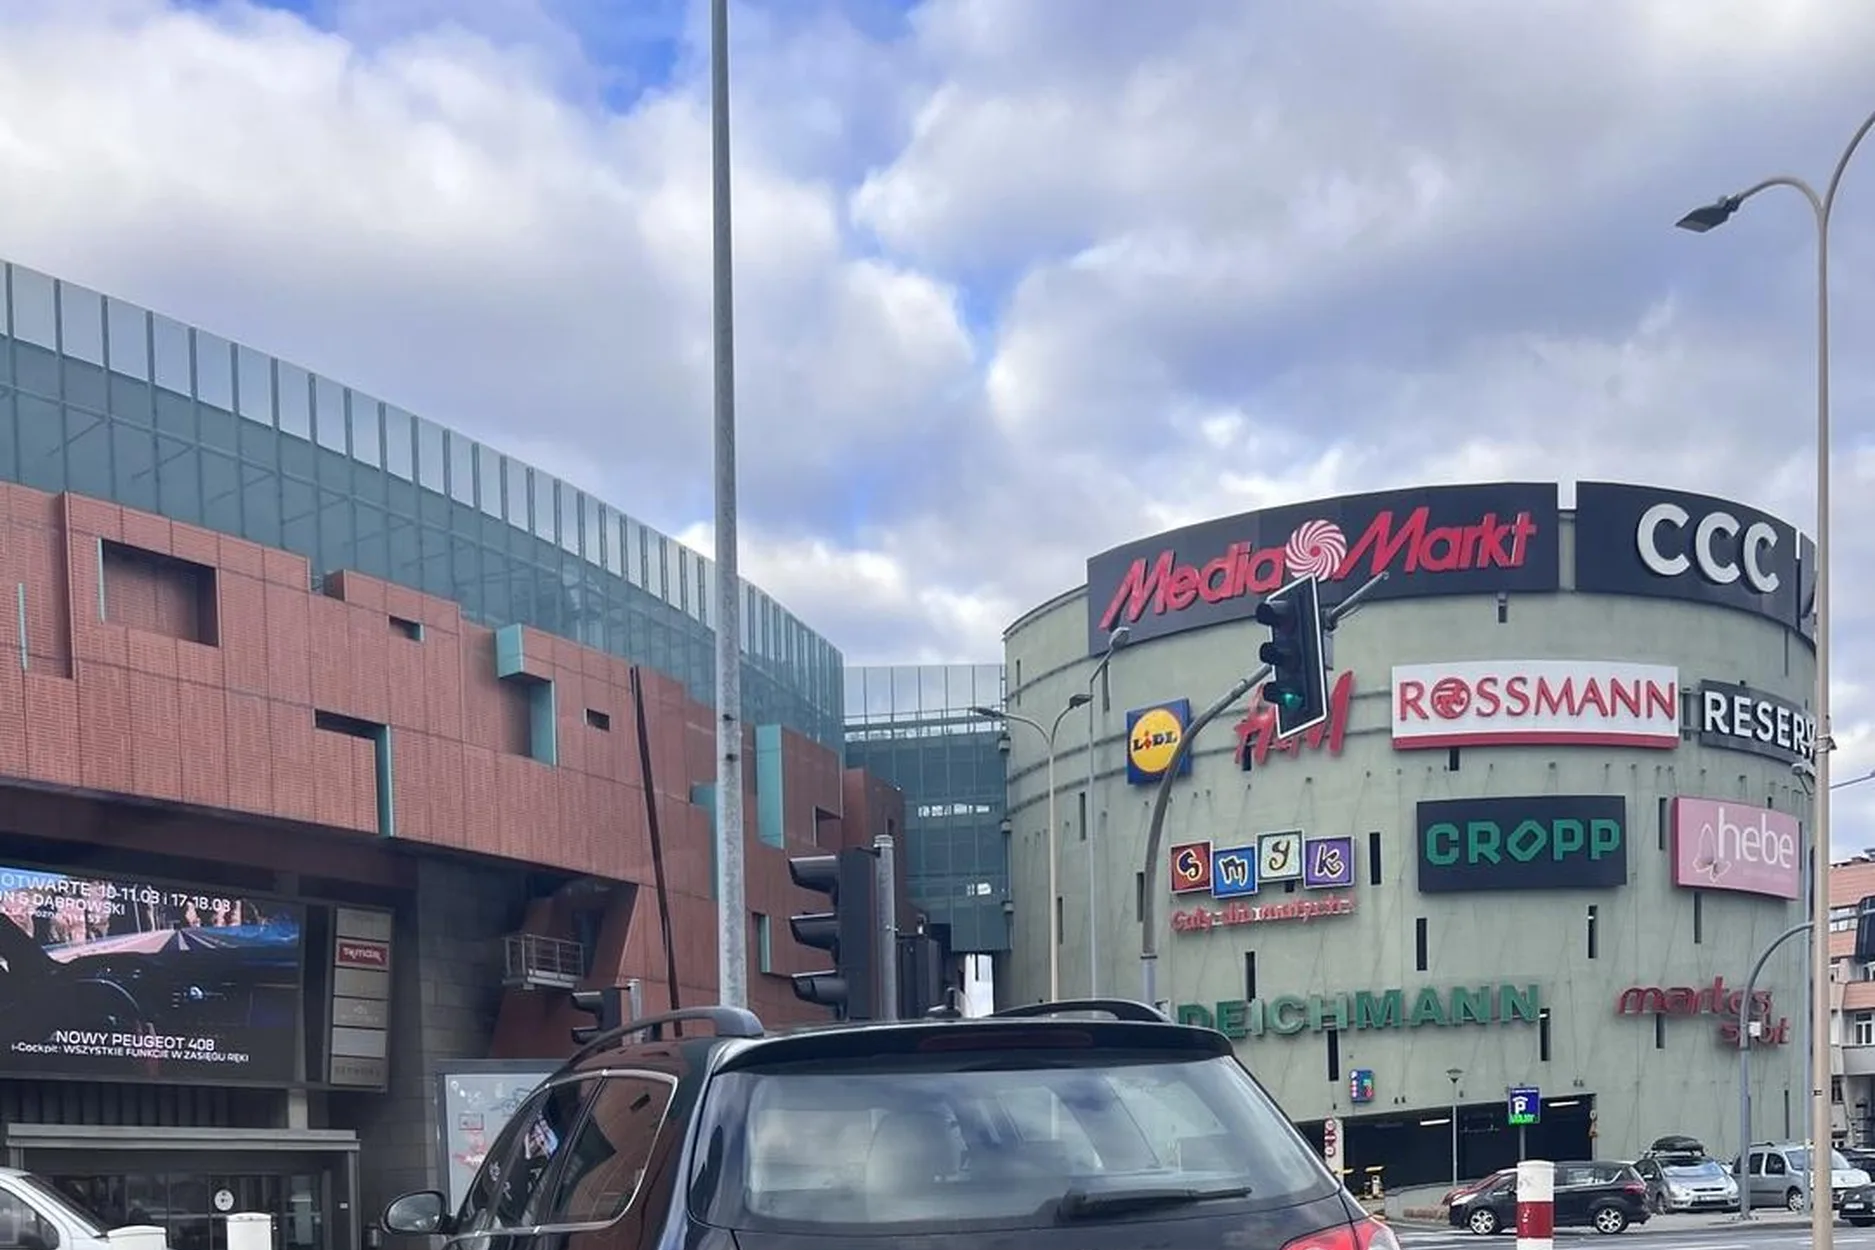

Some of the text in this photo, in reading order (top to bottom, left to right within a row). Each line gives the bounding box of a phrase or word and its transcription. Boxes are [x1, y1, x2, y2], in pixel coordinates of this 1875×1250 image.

[1637, 503, 1779, 592] CCC
[1399, 676, 1675, 721] ROSSMANN
[1426, 819, 1621, 866] CROPP
[1718, 797, 1794, 869] hebe
[1, 873, 91, 897] OTWARTE
[1178, 984, 1540, 1038] DEICHMANN
[56, 1030, 215, 1051] NOWY PEUGEOT 408
[63, 1044, 124, 1056] WSZYSTKIE
